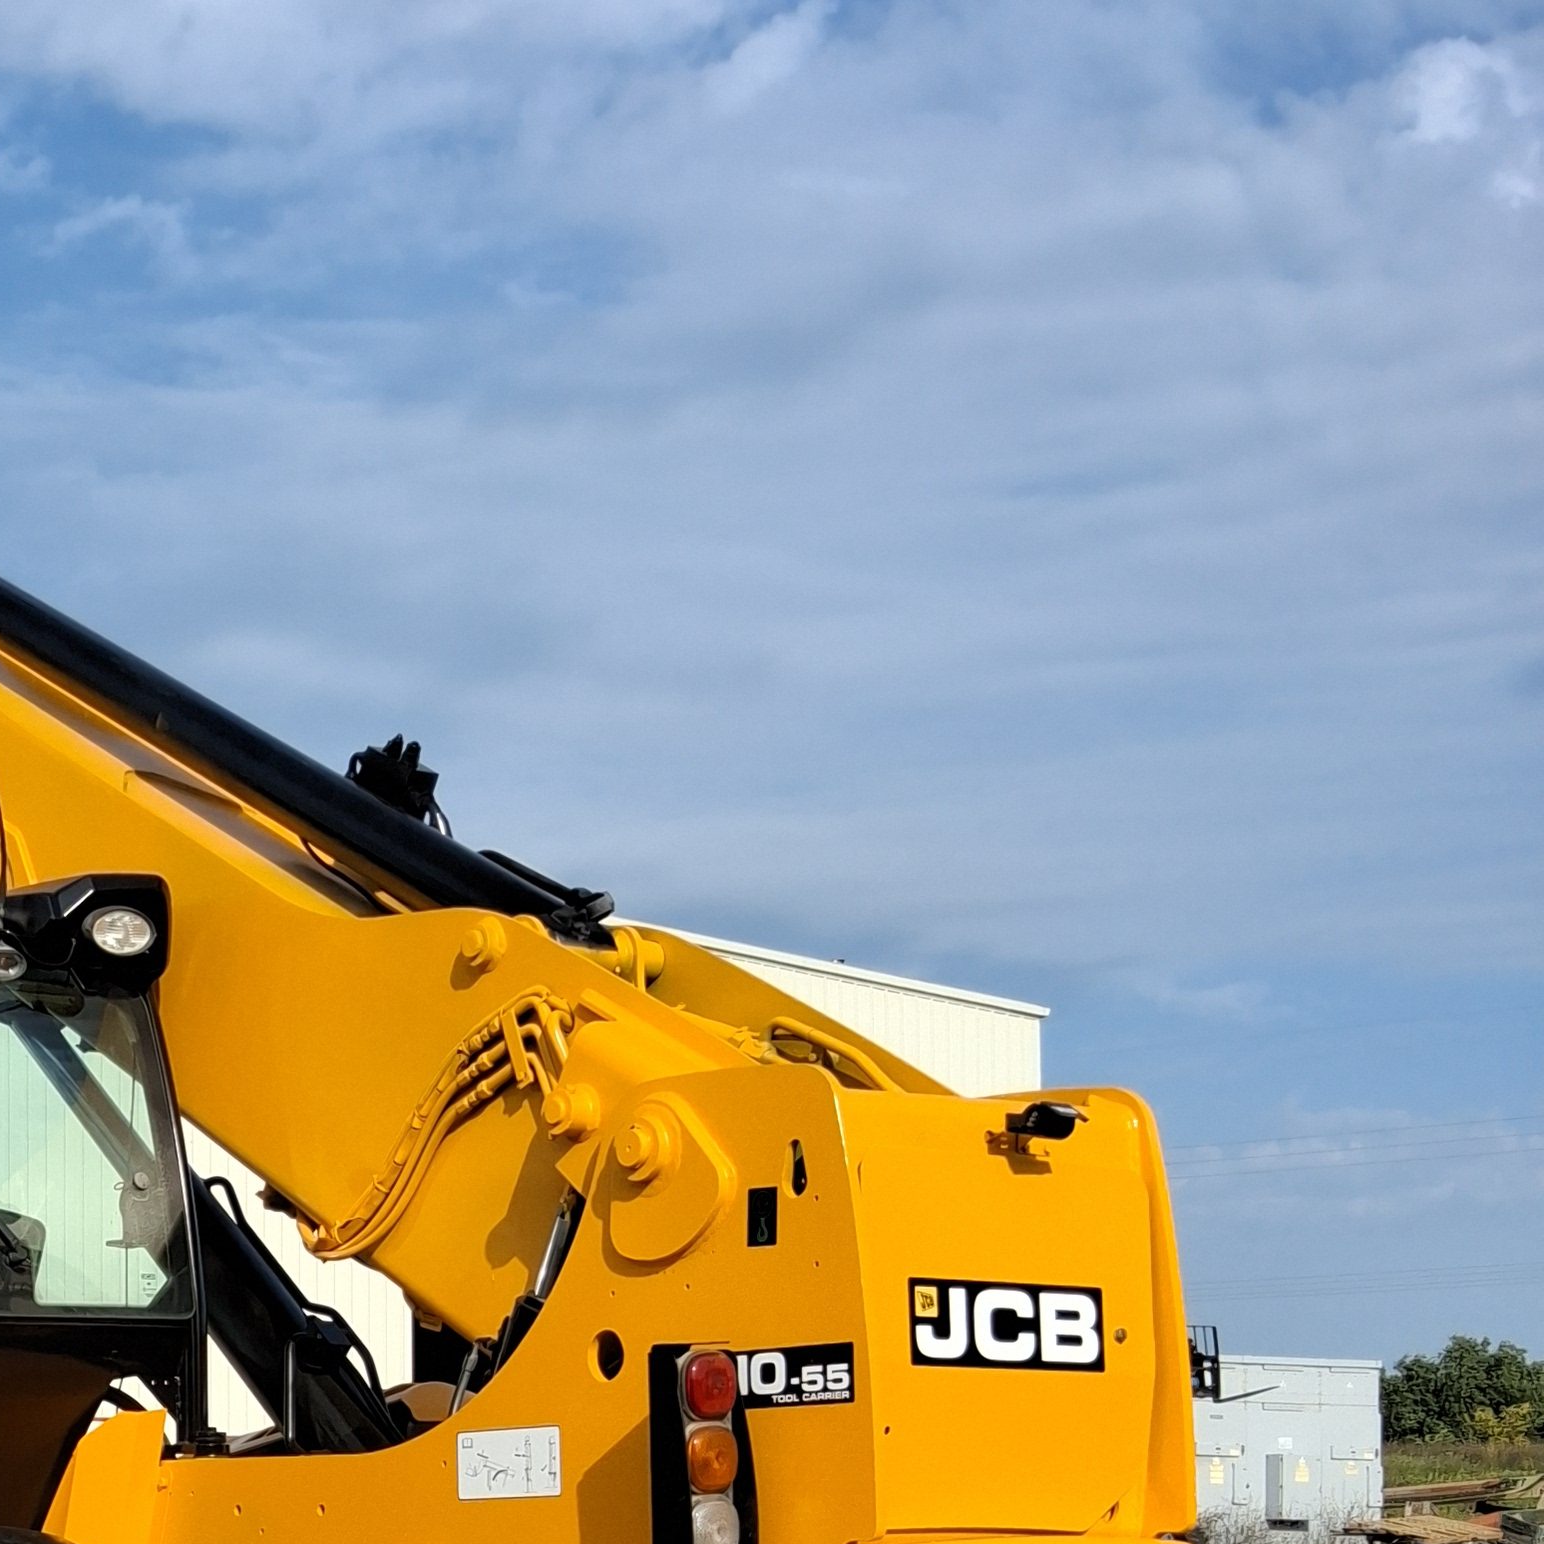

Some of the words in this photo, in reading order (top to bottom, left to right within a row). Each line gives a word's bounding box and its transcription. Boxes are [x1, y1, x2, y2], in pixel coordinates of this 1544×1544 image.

[914, 1287, 1100, 1364] JCB
[736, 1351, 851, 1396] 10-55
[772, 1394, 800, 1404] TOOL
[802, 1390, 851, 1402] CARRIER
